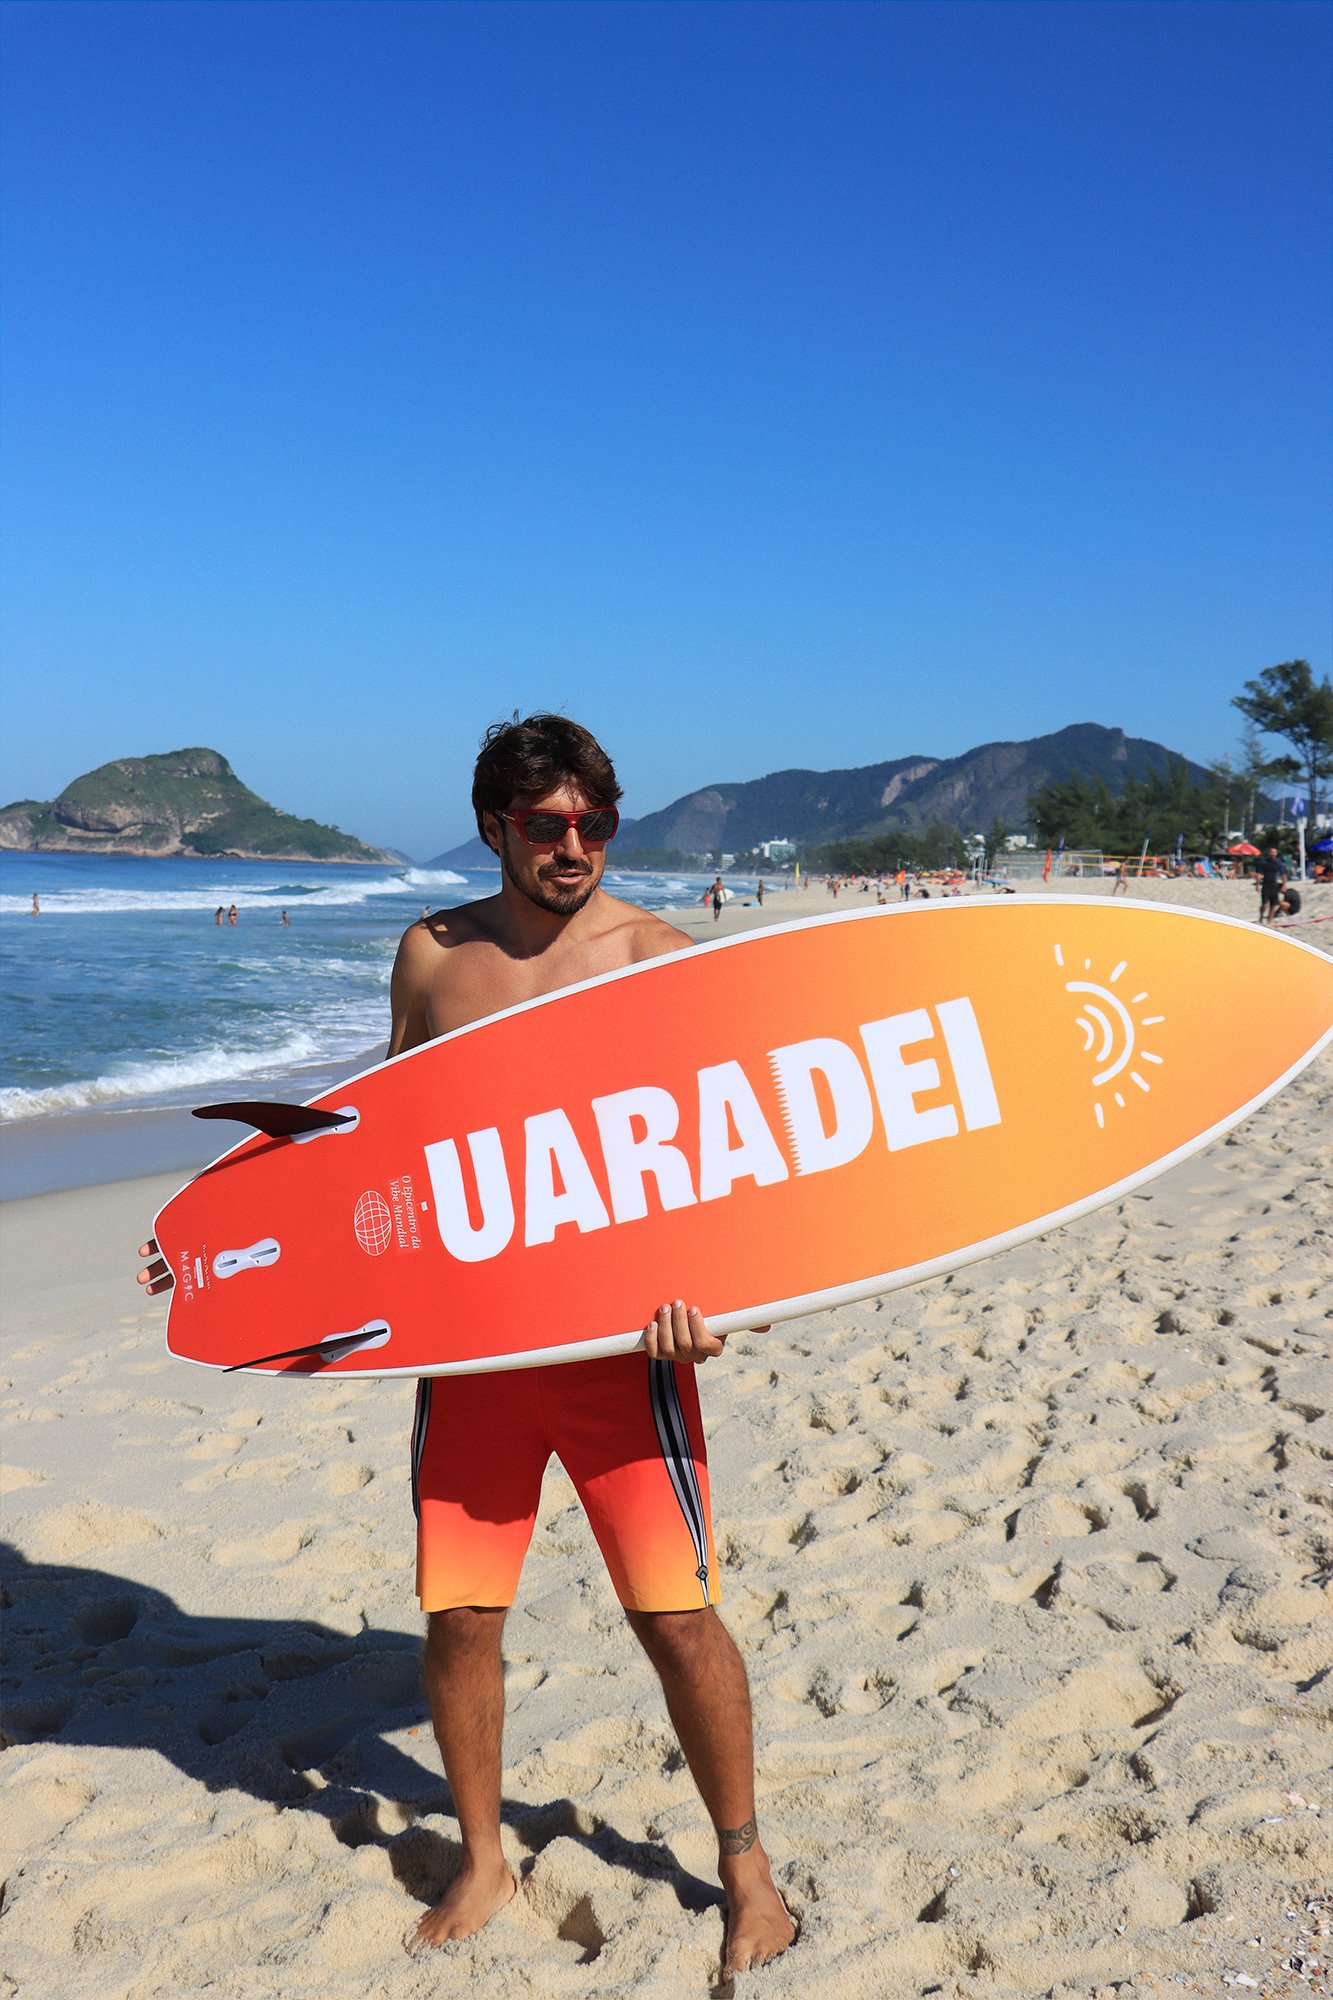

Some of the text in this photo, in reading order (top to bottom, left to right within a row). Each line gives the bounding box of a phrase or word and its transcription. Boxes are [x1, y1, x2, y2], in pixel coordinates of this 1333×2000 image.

[424, 998, 1002, 1262] UARADEI
[390, 1180, 409, 1248] Vibe Mundial
[402, 1186, 416, 1233] Epicentro
[411, 1236, 421, 1249] da
